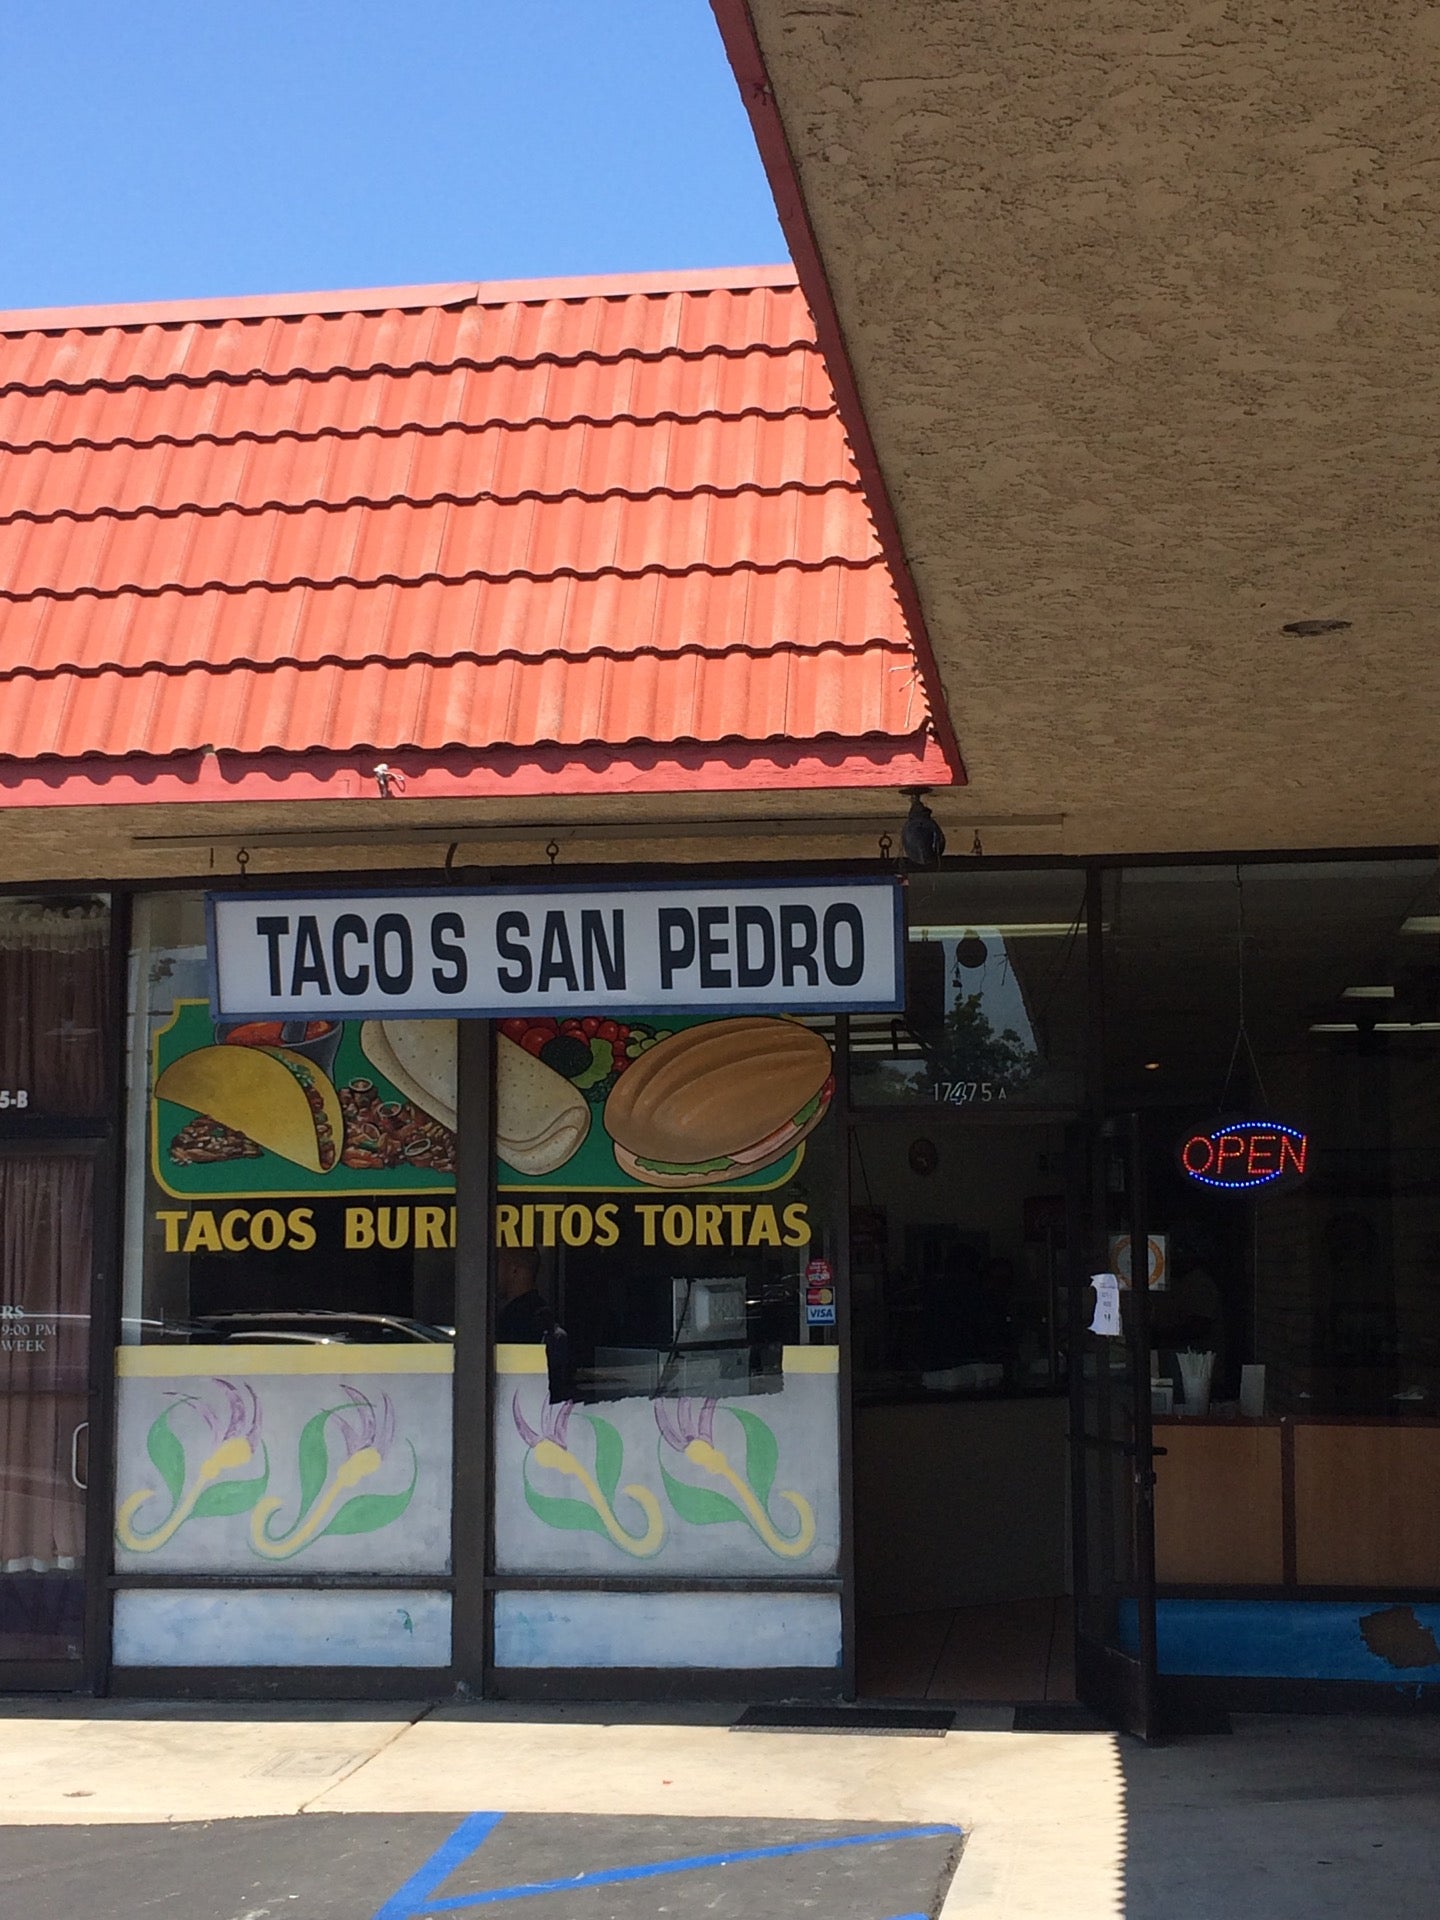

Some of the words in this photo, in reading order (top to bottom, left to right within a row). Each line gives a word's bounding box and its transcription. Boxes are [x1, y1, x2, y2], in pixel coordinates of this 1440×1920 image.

[256, 911, 469, 997] TACOS
[495, 908, 627, 994] SAN
[657, 902, 866, 990] PEDRO
[933, 1081, 993, 1105] 17475
[1182, 1135, 1308, 1175] OPEN
[155, 1207, 317, 1252] TACOS
[634, 1203, 812, 1247] TORTAS
[810, 1308, 833, 1318] VISA
[1, 1323, 30, 1336] 9:00
[35, 1323, 57, 1336] PM
[1, 1339, 46, 1352] WEEK
